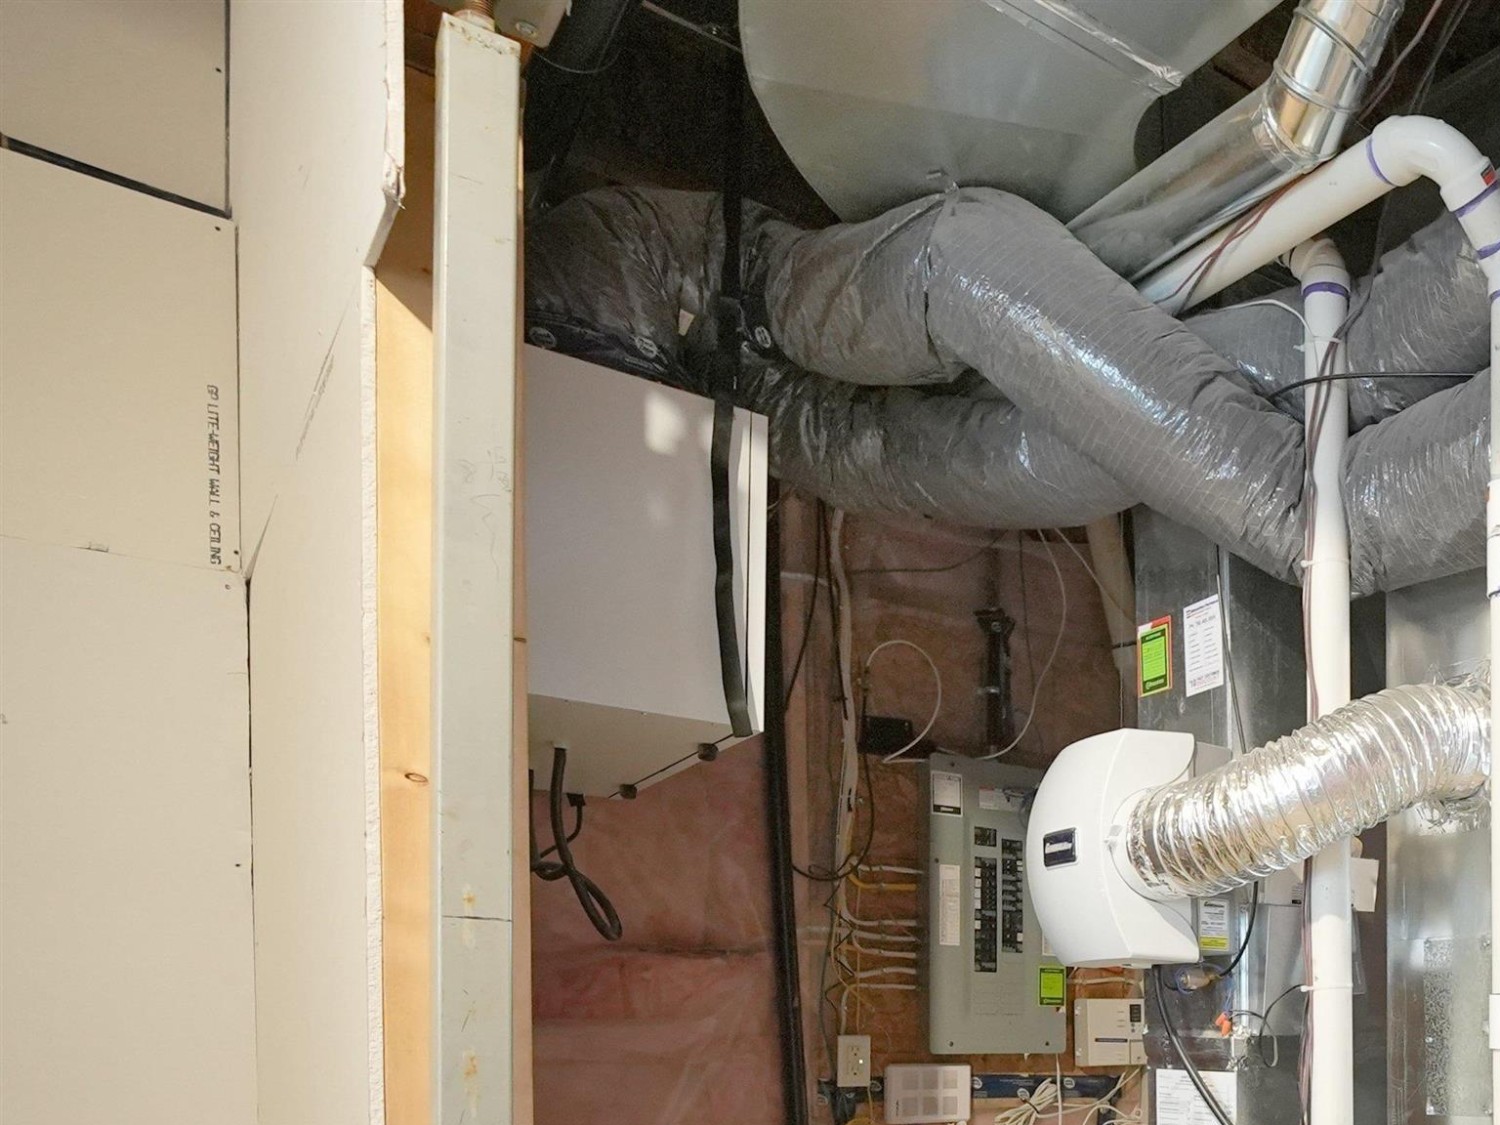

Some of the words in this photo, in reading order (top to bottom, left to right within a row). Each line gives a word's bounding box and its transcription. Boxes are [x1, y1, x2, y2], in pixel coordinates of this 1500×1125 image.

[207, 403, 220, 475] LITE-WEIGHT
[209, 478, 221, 506] WALL
[209, 522, 222, 565] CEILING
